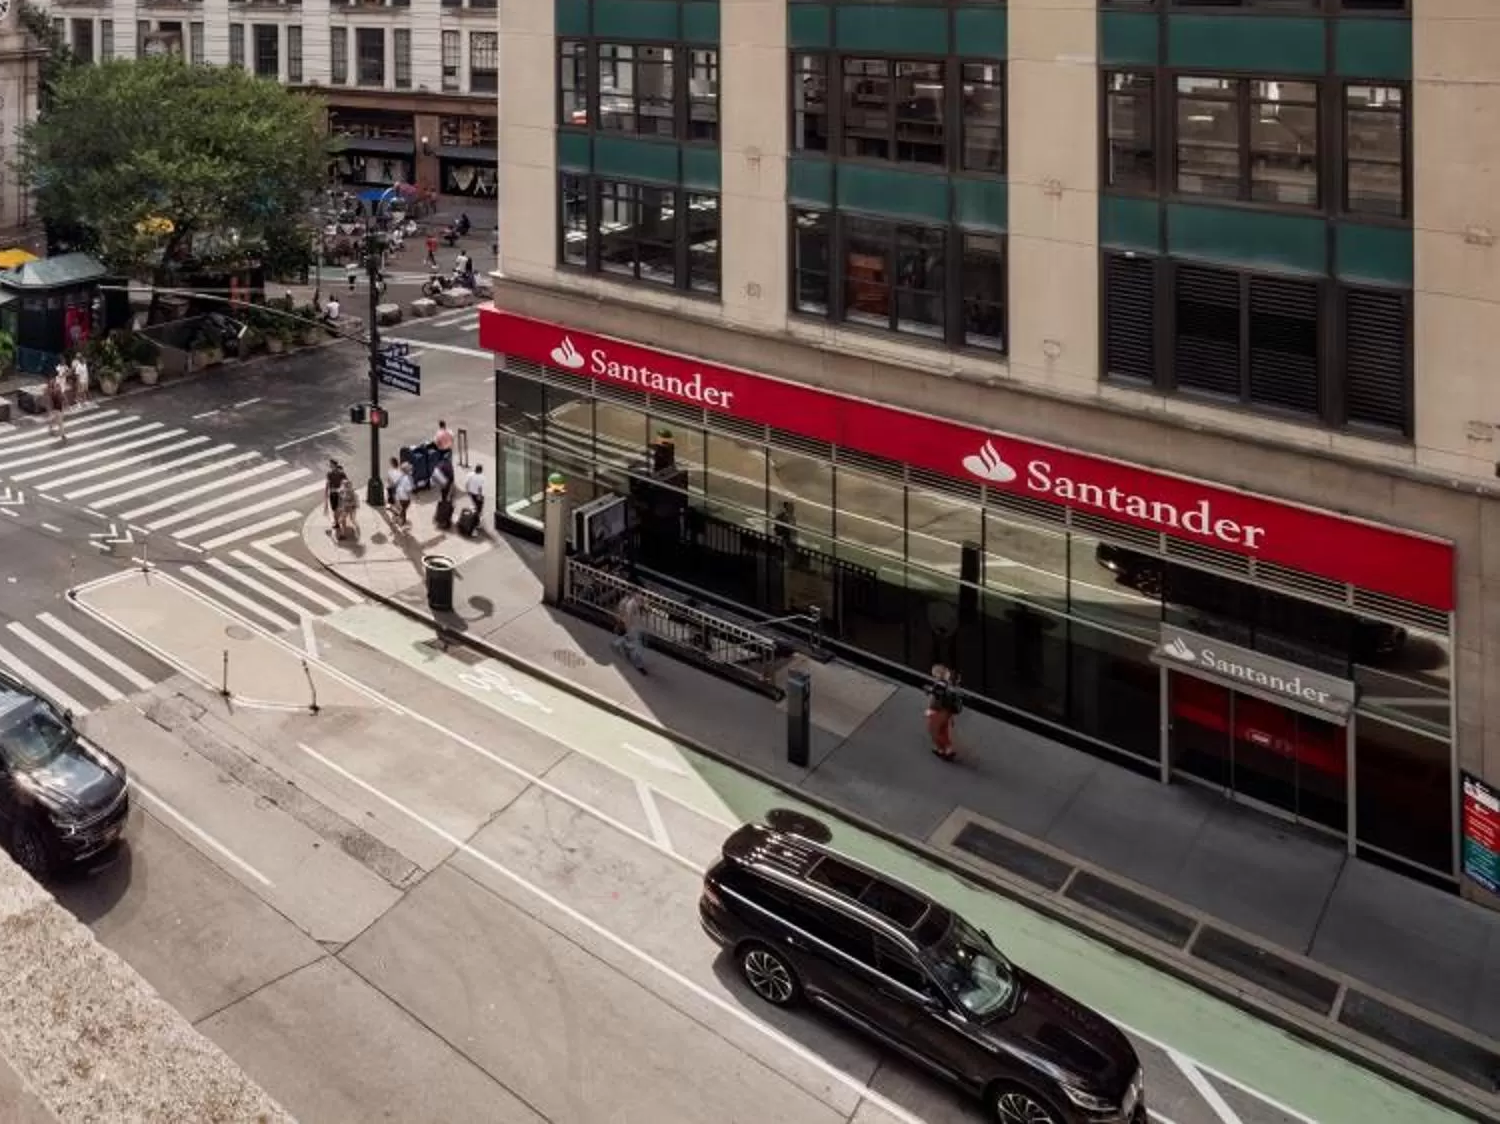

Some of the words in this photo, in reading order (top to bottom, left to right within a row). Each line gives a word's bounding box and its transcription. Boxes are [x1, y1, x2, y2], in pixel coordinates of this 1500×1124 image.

[590, 348, 735, 409] Santander
[1027, 459, 1266, 549] Santander
[1201, 648, 1330, 704] Santander
